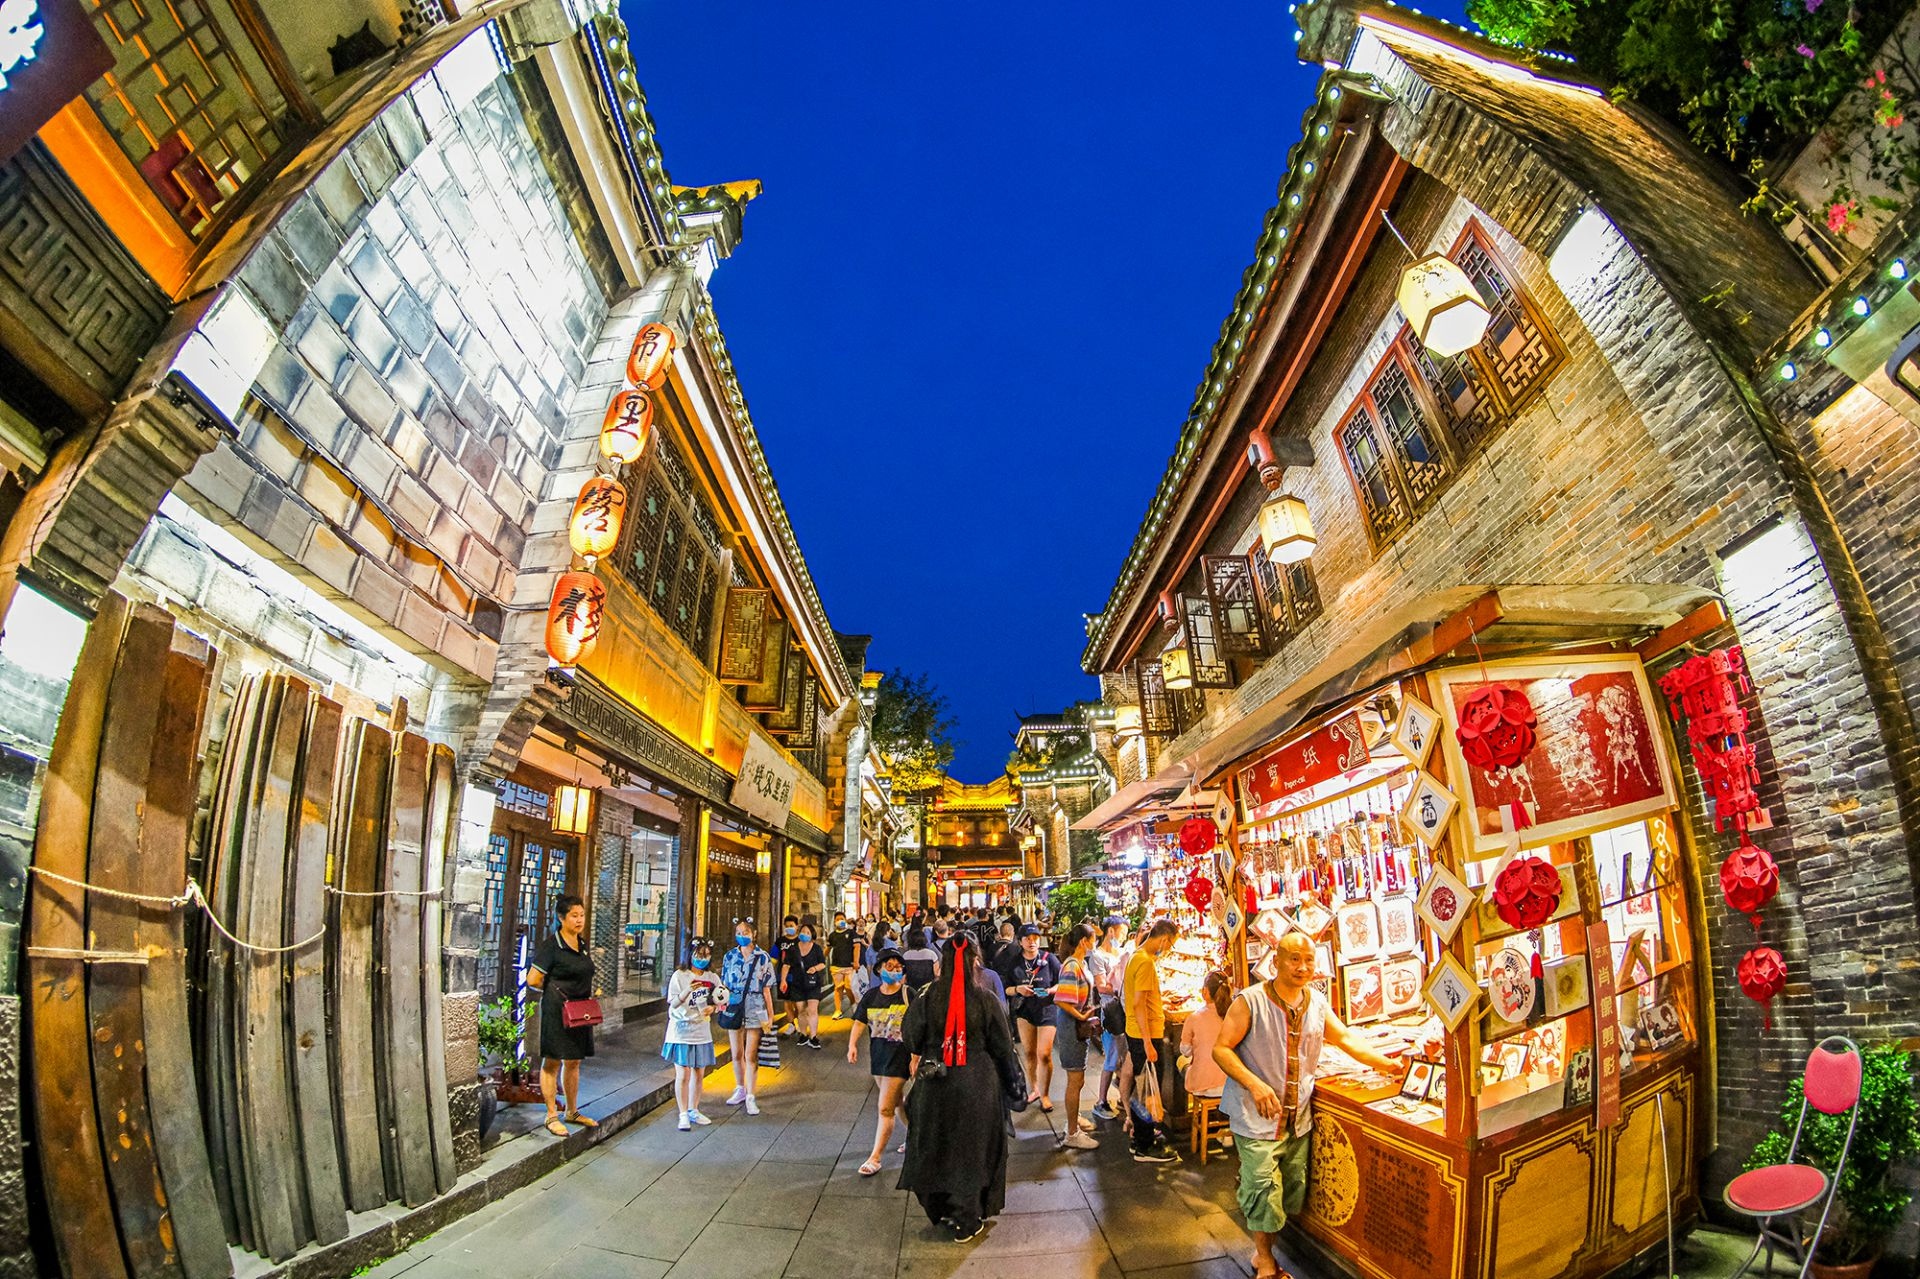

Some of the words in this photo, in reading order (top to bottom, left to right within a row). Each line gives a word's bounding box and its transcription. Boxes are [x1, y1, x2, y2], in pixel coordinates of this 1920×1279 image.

[1266, 745, 1321, 788] 剪纸
[1284, 775, 1306, 790] Paper-cut
[1597, 965, 1616, 1078] 肖像剪影
